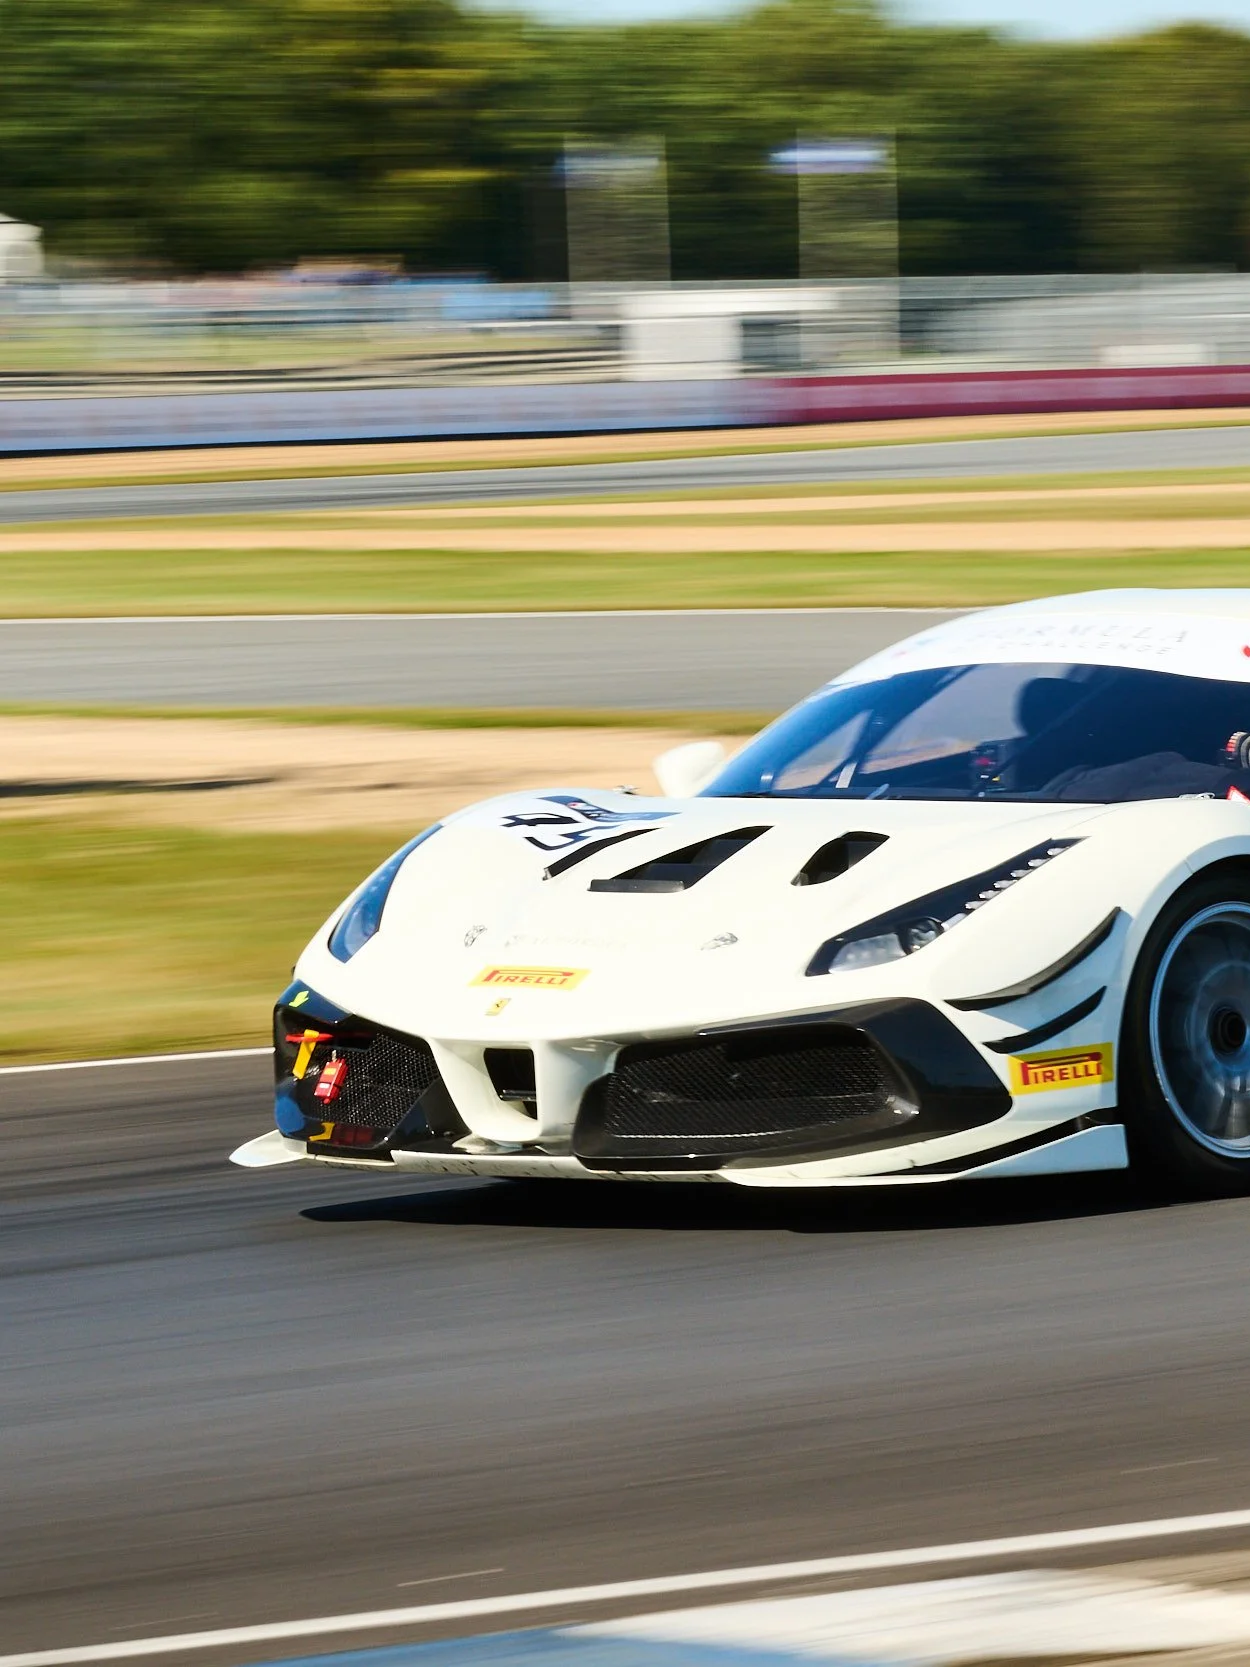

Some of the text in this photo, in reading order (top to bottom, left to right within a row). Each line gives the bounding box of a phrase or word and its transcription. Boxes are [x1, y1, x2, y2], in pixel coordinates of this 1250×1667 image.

[499, 812, 621, 851] 45
[482, 969, 575, 985] PIRELLI
[1020, 1051, 1103, 1086] PIRELLI
